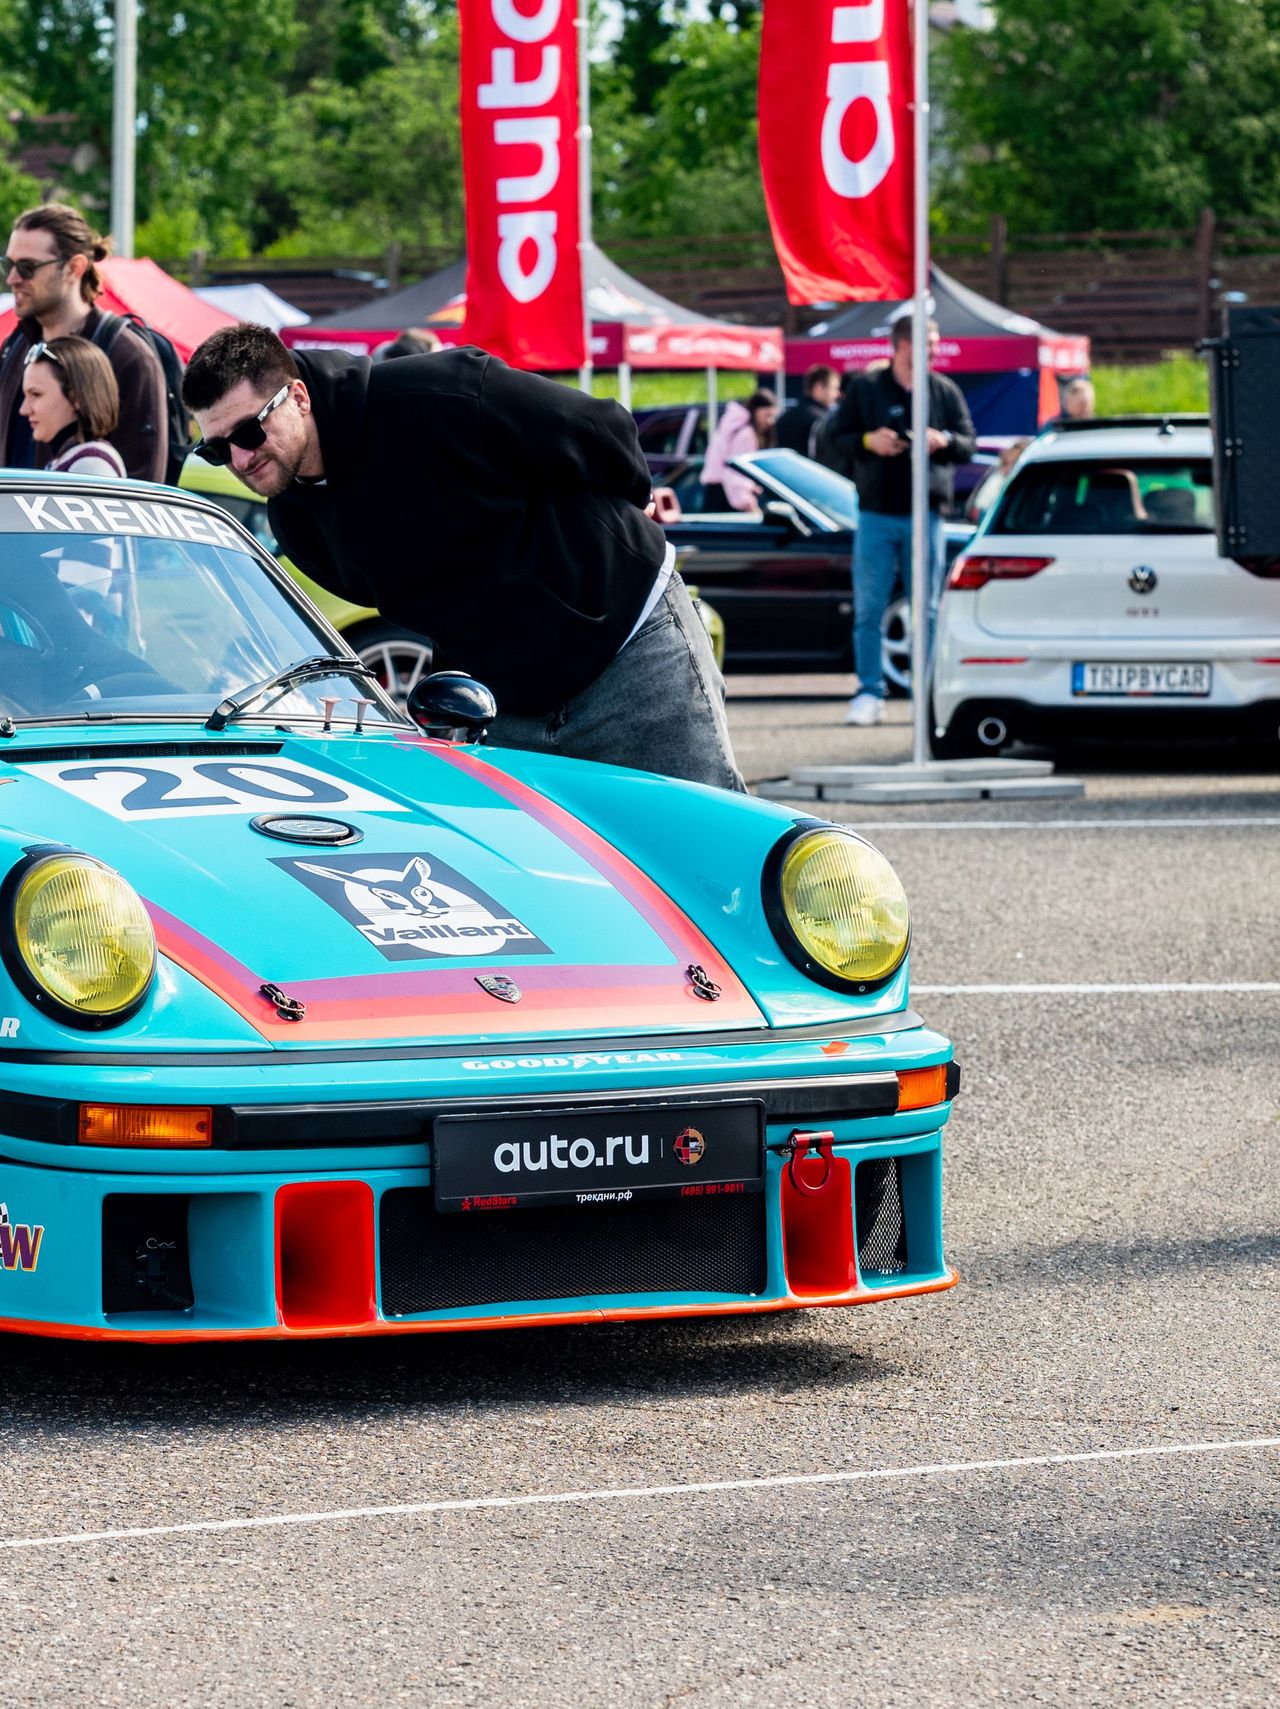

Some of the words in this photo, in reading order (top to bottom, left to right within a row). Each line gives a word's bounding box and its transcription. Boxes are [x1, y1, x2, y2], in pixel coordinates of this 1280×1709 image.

[13, 495, 252, 551] KREMER
[1090, 666, 1206, 688] TRIPBYCAR
[58, 762, 349, 811] 20
[364, 922, 529, 942] Vaillant
[494, 1135, 649, 1173] auto.ru
[576, 1190, 633, 1203] трекдни.рф
[681, 1185, 703, 1197] (495)
[706, 1183, 745, 1195] 991-9811
[473, 1195, 517, 1207] RedStars
